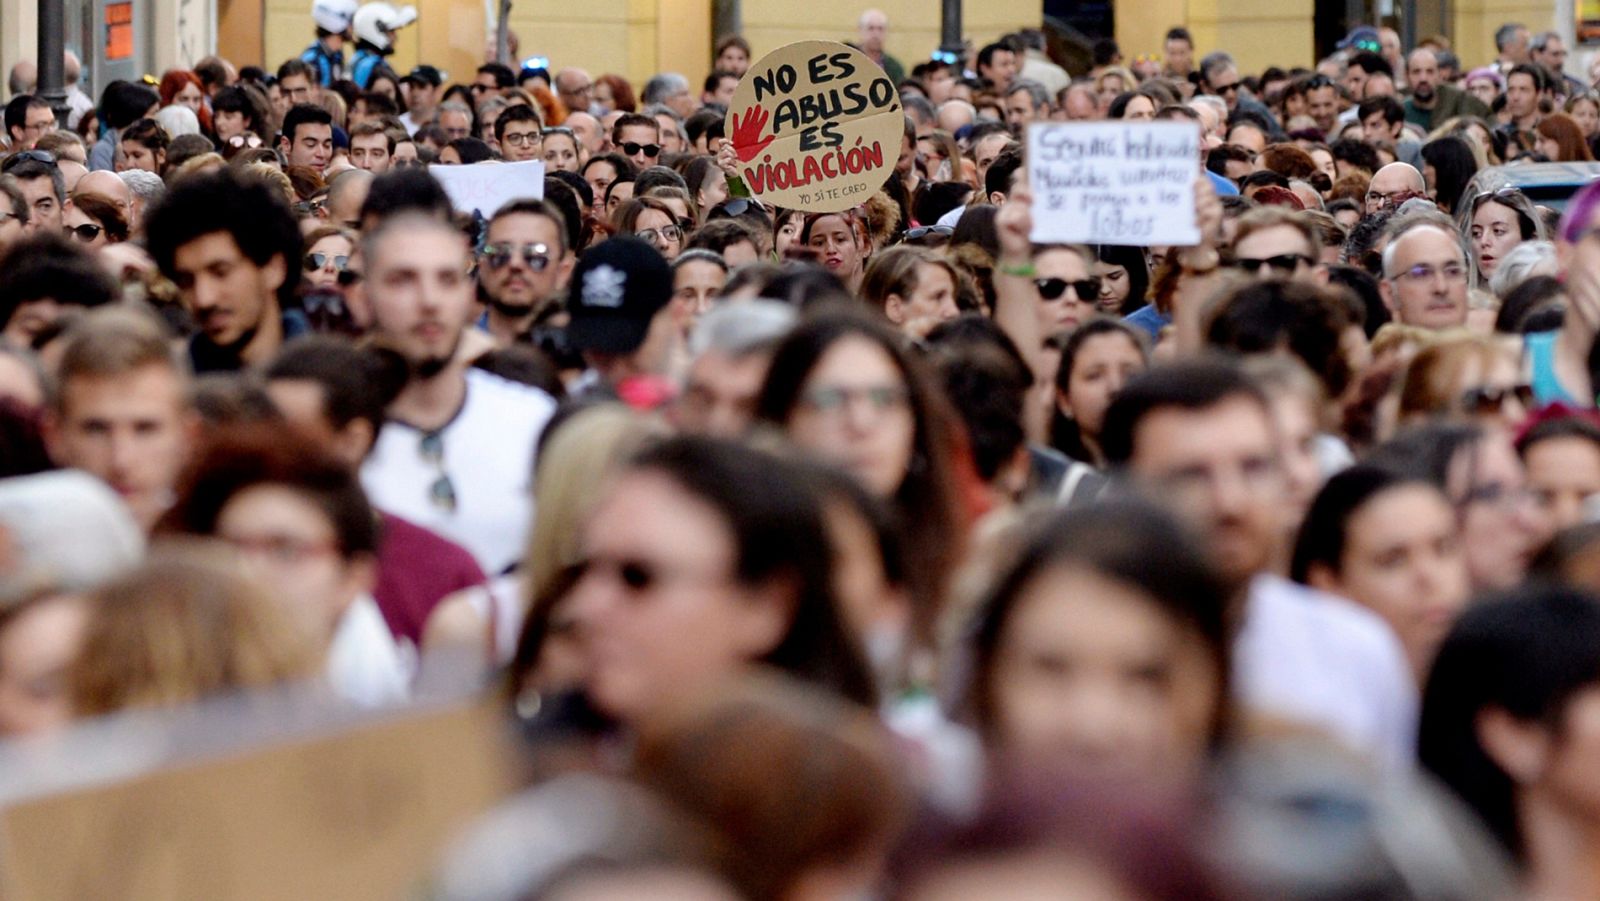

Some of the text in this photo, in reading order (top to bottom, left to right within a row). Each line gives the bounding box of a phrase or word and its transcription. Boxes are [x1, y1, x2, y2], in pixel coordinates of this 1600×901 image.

[753, 53, 856, 102] NO ES
[773, 78, 898, 134] ABUSO,
[799, 121, 844, 152] ES
[798, 193, 811, 204] YO
[826, 188, 840, 199] TE
[842, 183, 867, 196] CREO
